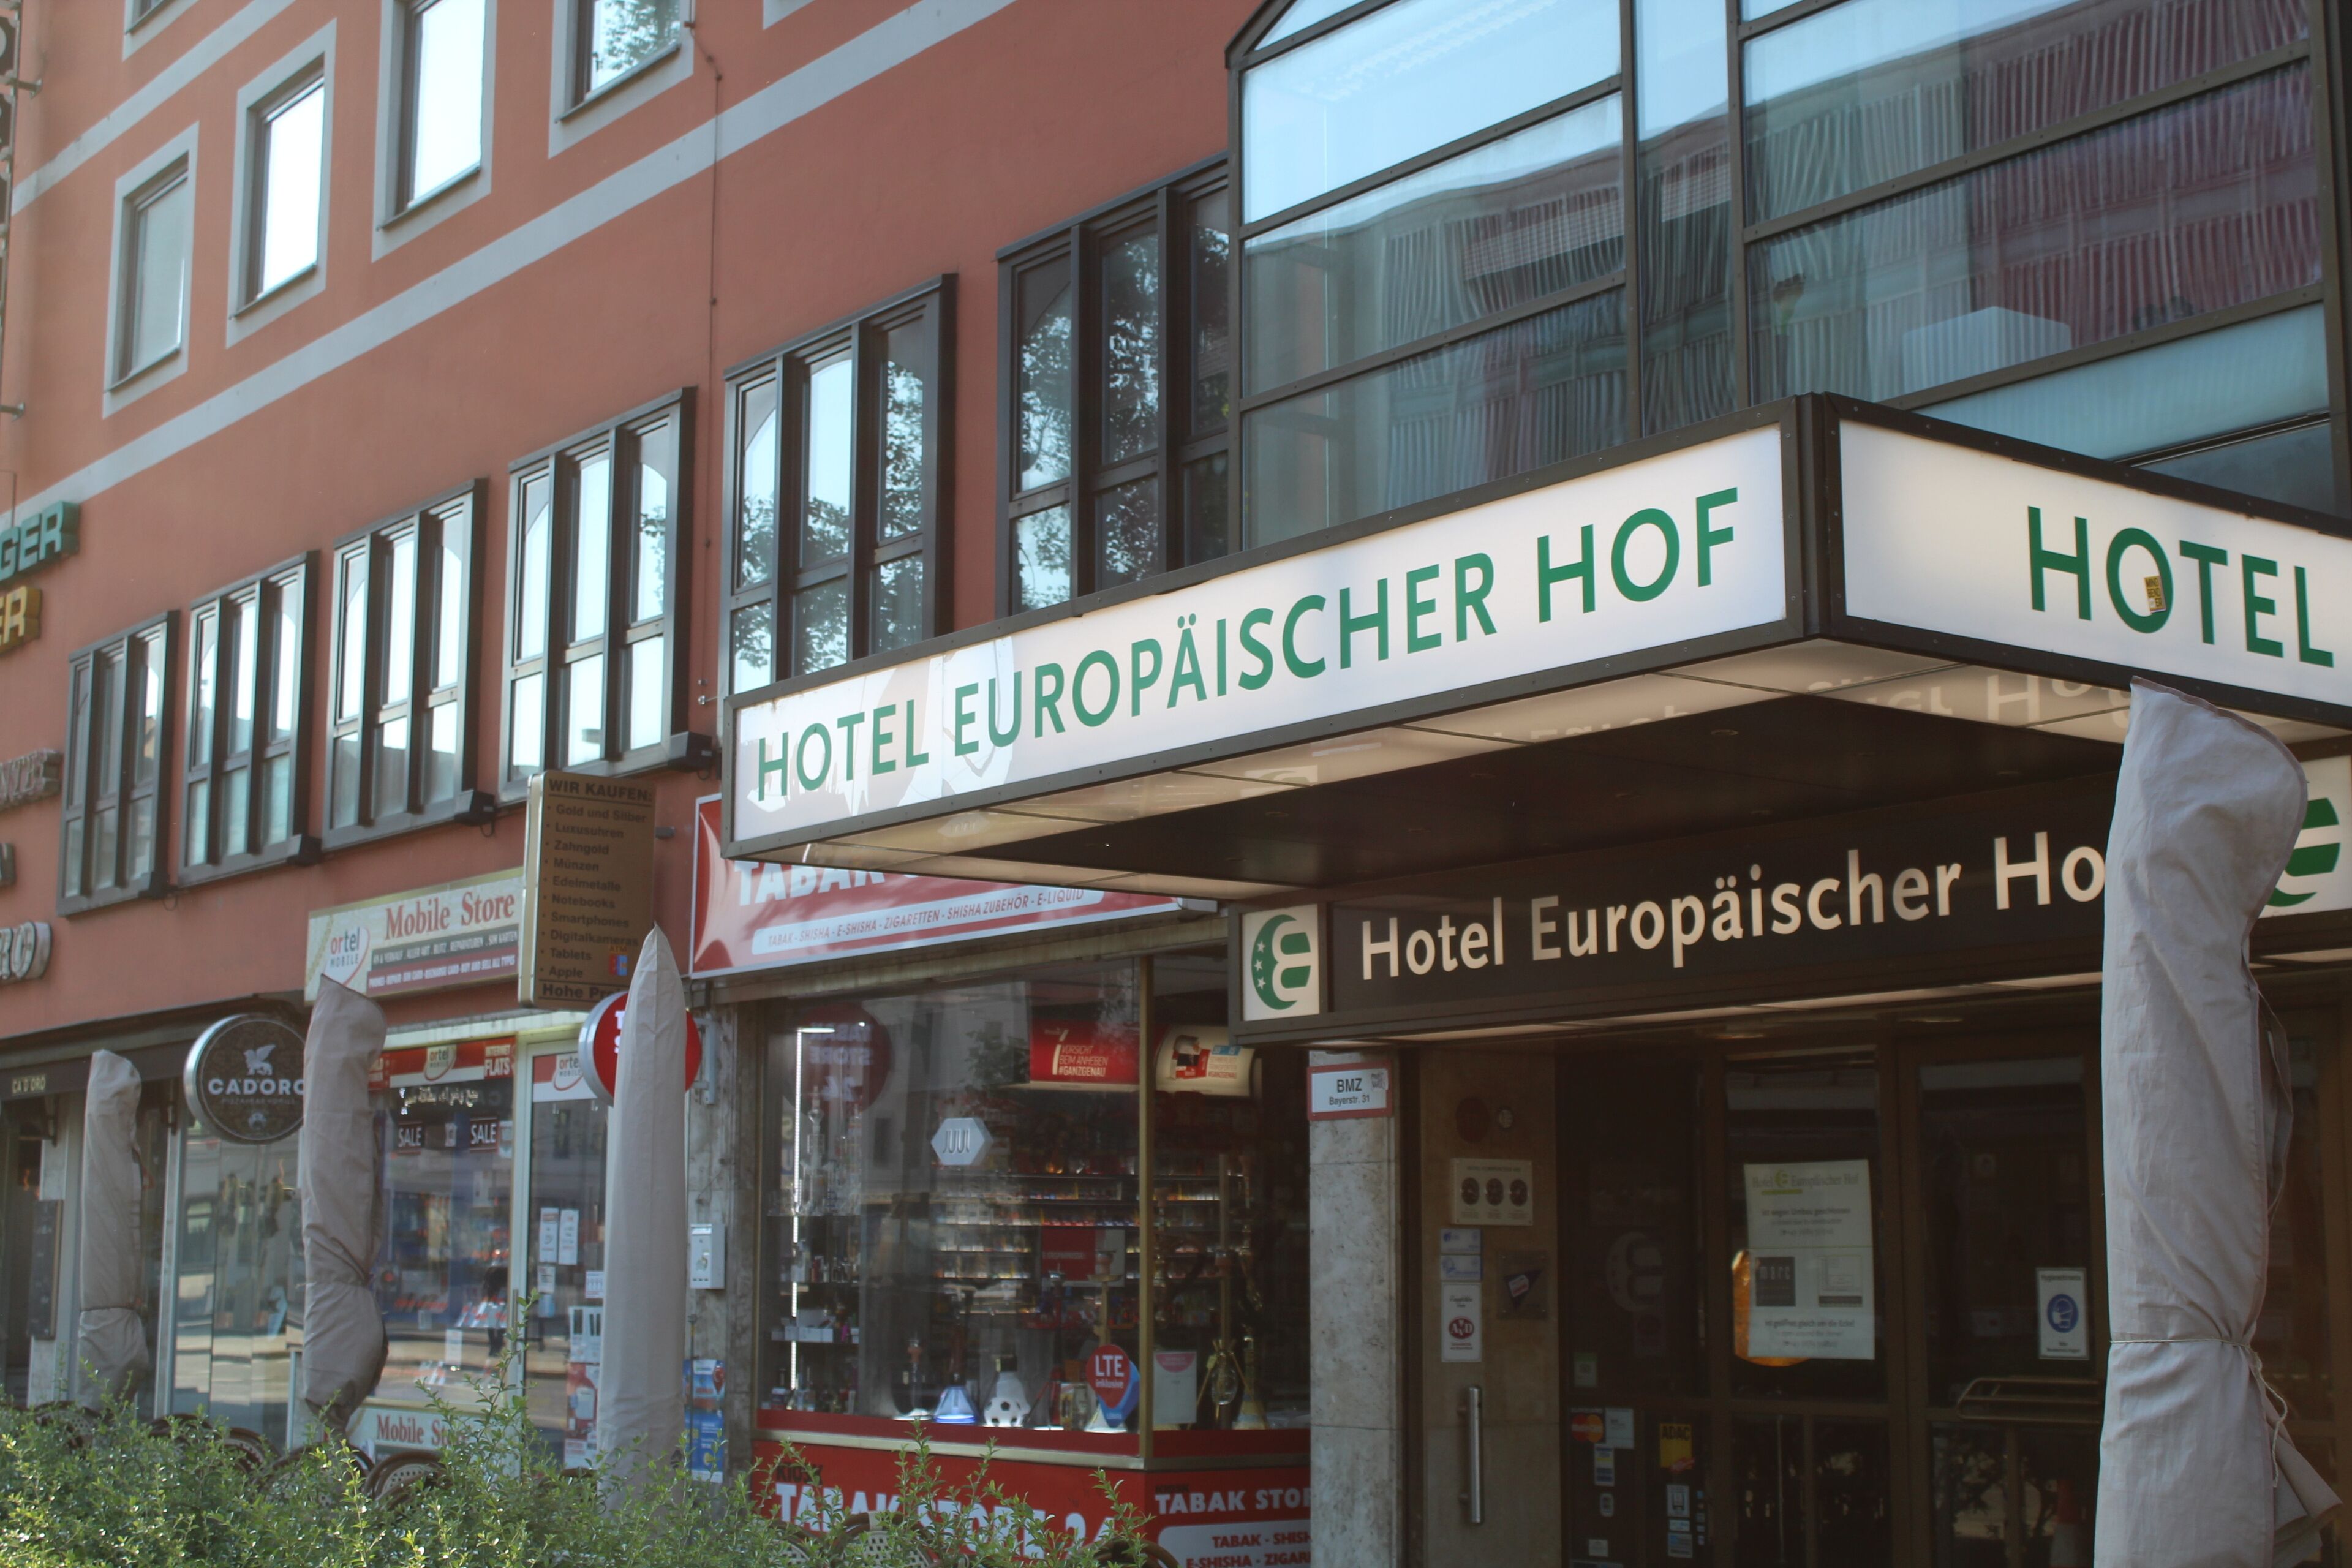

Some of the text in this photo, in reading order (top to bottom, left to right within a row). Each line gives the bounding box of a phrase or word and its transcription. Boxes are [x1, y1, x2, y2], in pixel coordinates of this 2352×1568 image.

[2027, 505, 2334, 668] HOTEL
[758, 487, 1738, 802] HOTEL EUROPÄISCHER HOF
[549, 778, 653, 802] WIR KAUFEN:
[556, 804, 647, 824] Gold und Silber
[556, 822, 624, 839] Luxusuhren
[554, 840, 609, 858] Zahngold
[554, 858, 599, 873] Münzen
[552, 876, 622, 892] Edelmetalle
[552, 894, 616, 910] Notebooks
[1363, 831, 2105, 980] Hotel Europäischer Ho
[385, 891, 515, 941] Mobile Store
[551, 911, 630, 930] Smartphones
[767, 933, 793, 947] TABAK
[799, 927, 830, 943] SHISHA
[837, 921, 877, 937] E-SHISHA
[884, 910, 940, 930] ZIGARETTEN
[947, 903, 981, 920] SHISHA
[982, 892, 1028, 914] ZUBEHÖR
[1037, 889, 1084, 906] E-LIQUID
[331, 927, 360, 954] ortel
[551, 930, 639, 947] Digitalkameras
[549, 947, 592, 962] Tablets
[549, 965, 583, 980] Apple
[542, 983, 585, 999] Hohe
[1061, 1045, 1093, 1055] VORSICHT
[484, 1058, 510, 1076] FLATS
[559, 1055, 580, 1069] orte
[1059, 1055, 1109, 1066] BEIM ANHEBEN
[1058, 1066, 1106, 1077] #GANZGENAU
[1336, 1077, 1362, 1094] BMZ
[1329, 1094, 1370, 1107] Bayerstr. 31
[398, 1126, 422, 1148] SALE
[470, 1123, 496, 1145] SALE
[1095, 1355, 1125, 1378] LTE
[376, 1414, 424, 1444] Mobile
[1155, 1490, 1246, 1515] TABAK
[1212, 1534, 1261, 1548] TABAK
[1186, 1555, 1252, 1568] E-SHISHA
